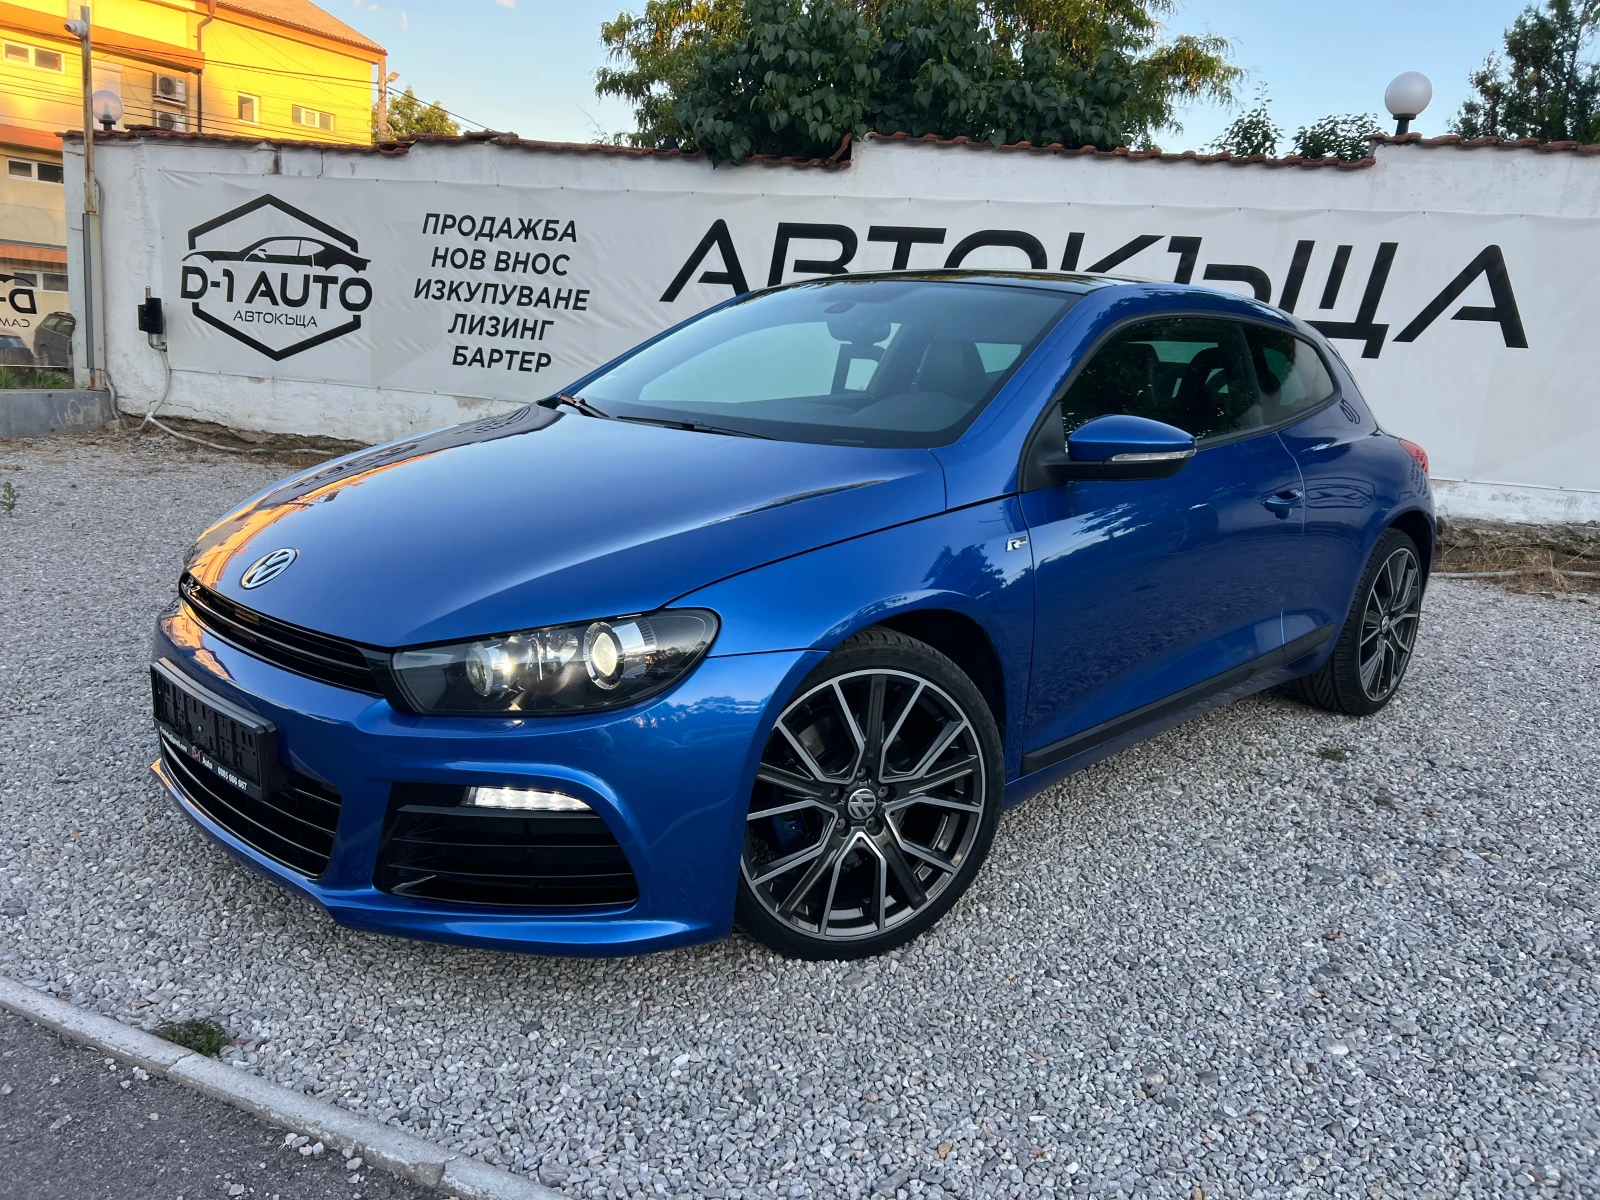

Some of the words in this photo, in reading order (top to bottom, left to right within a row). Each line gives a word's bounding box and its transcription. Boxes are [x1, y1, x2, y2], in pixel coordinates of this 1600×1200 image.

[422, 213, 577, 243] ПРОДАЖБА
[431, 247, 486, 270] НОВ
[494, 250, 571, 276] ВНОС
[181, 266, 235, 303] D-1
[245, 270, 373, 312] AUTO
[413, 278, 591, 311] ИЗКУПУВАНЕ
[233, 310, 318, 329] АВТОКЪЩА
[448, 313, 554, 341] ЛИЗИНГ
[452, 346, 552, 373] БАРТЕР
